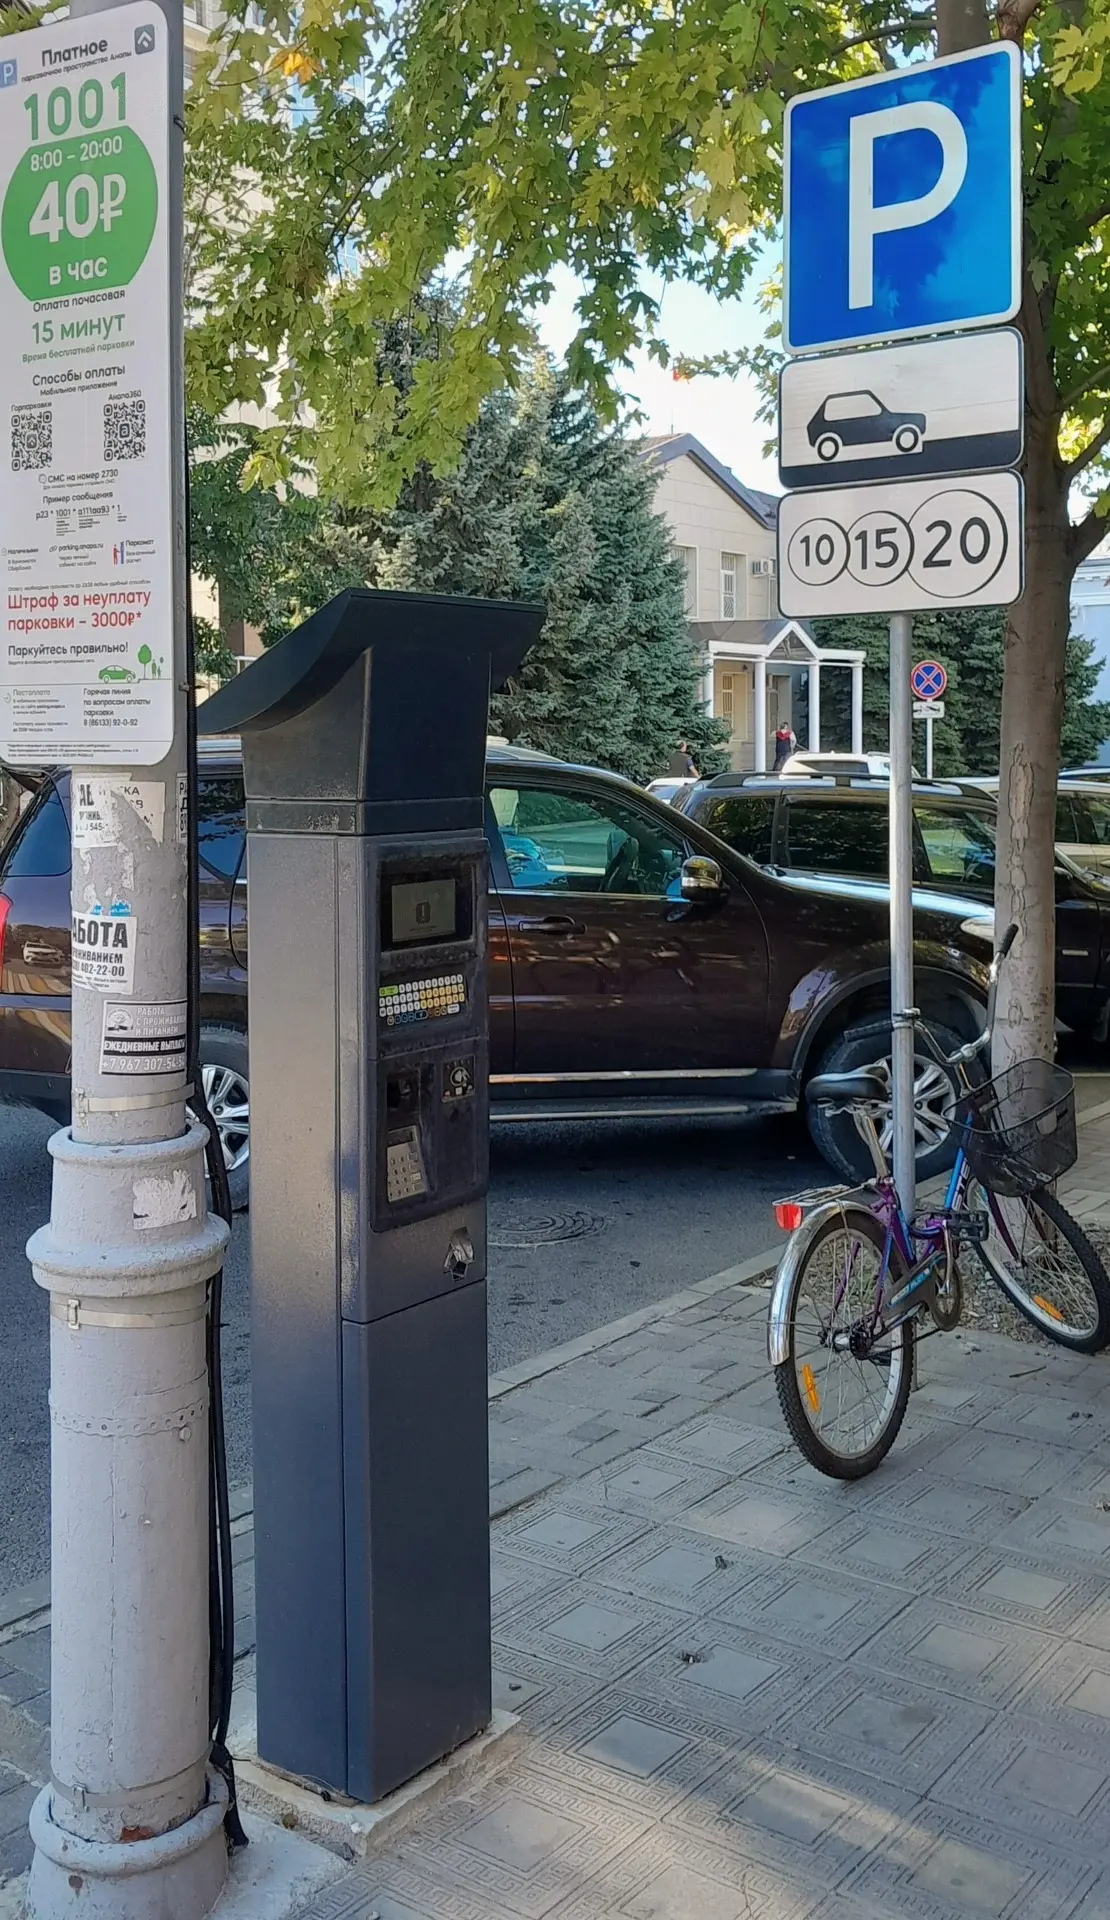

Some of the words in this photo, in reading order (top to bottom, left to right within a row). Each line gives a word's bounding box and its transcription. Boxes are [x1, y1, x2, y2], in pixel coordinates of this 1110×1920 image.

[41, 38, 108, 67] Платное
[24, 71, 126, 141] 1001
[30, 148, 62, 172] 8:00
[80, 135, 122, 162] 20:00
[29, 173, 127, 243] 40₽
[849, 100, 969, 309] P
[49, 265, 61, 286] в
[67, 256, 108, 281] час
[33, 300, 70, 313] Оплата
[72, 289, 125, 309] почасовая
[32, 320, 54, 344] 15
[61, 314, 125, 340] минут
[22, 351, 47, 363] Время
[49, 343, 96, 359] бесплатной
[97, 339, 135, 352] парковки
[32, 368, 82, 387] Способы
[85, 365, 125, 380] оплаты
[40, 386, 76, 397] Мобильное
[78, 380, 118, 392] приложение
[48, 474, 65, 483] СМС
[67, 473, 75, 481] на
[77, 472, 99, 482] номер
[101, 469, 118, 478] 2730
[43, 496, 70, 506] Пример
[72, 491, 113, 502] сообщения
[56, 509, 71, 517] 1001
[799, 534, 834, 567] 10
[855, 527, 899, 570] 15
[923, 516, 990, 568] 20
[8, 592, 58, 612] Штраф
[63, 597, 79, 606] за
[83, 591, 151, 609] неуплату
[8, 614, 75, 633] парковки
[8, 644, 67, 659] Паркуйтесь
[70, 642, 129, 658] правильно!
[83, 688, 110, 696] Горячая
[104, 1040, 160, 1053] ЕЖЕДНЕВНЫЕ
[120, 1058, 141, 1071] 967
